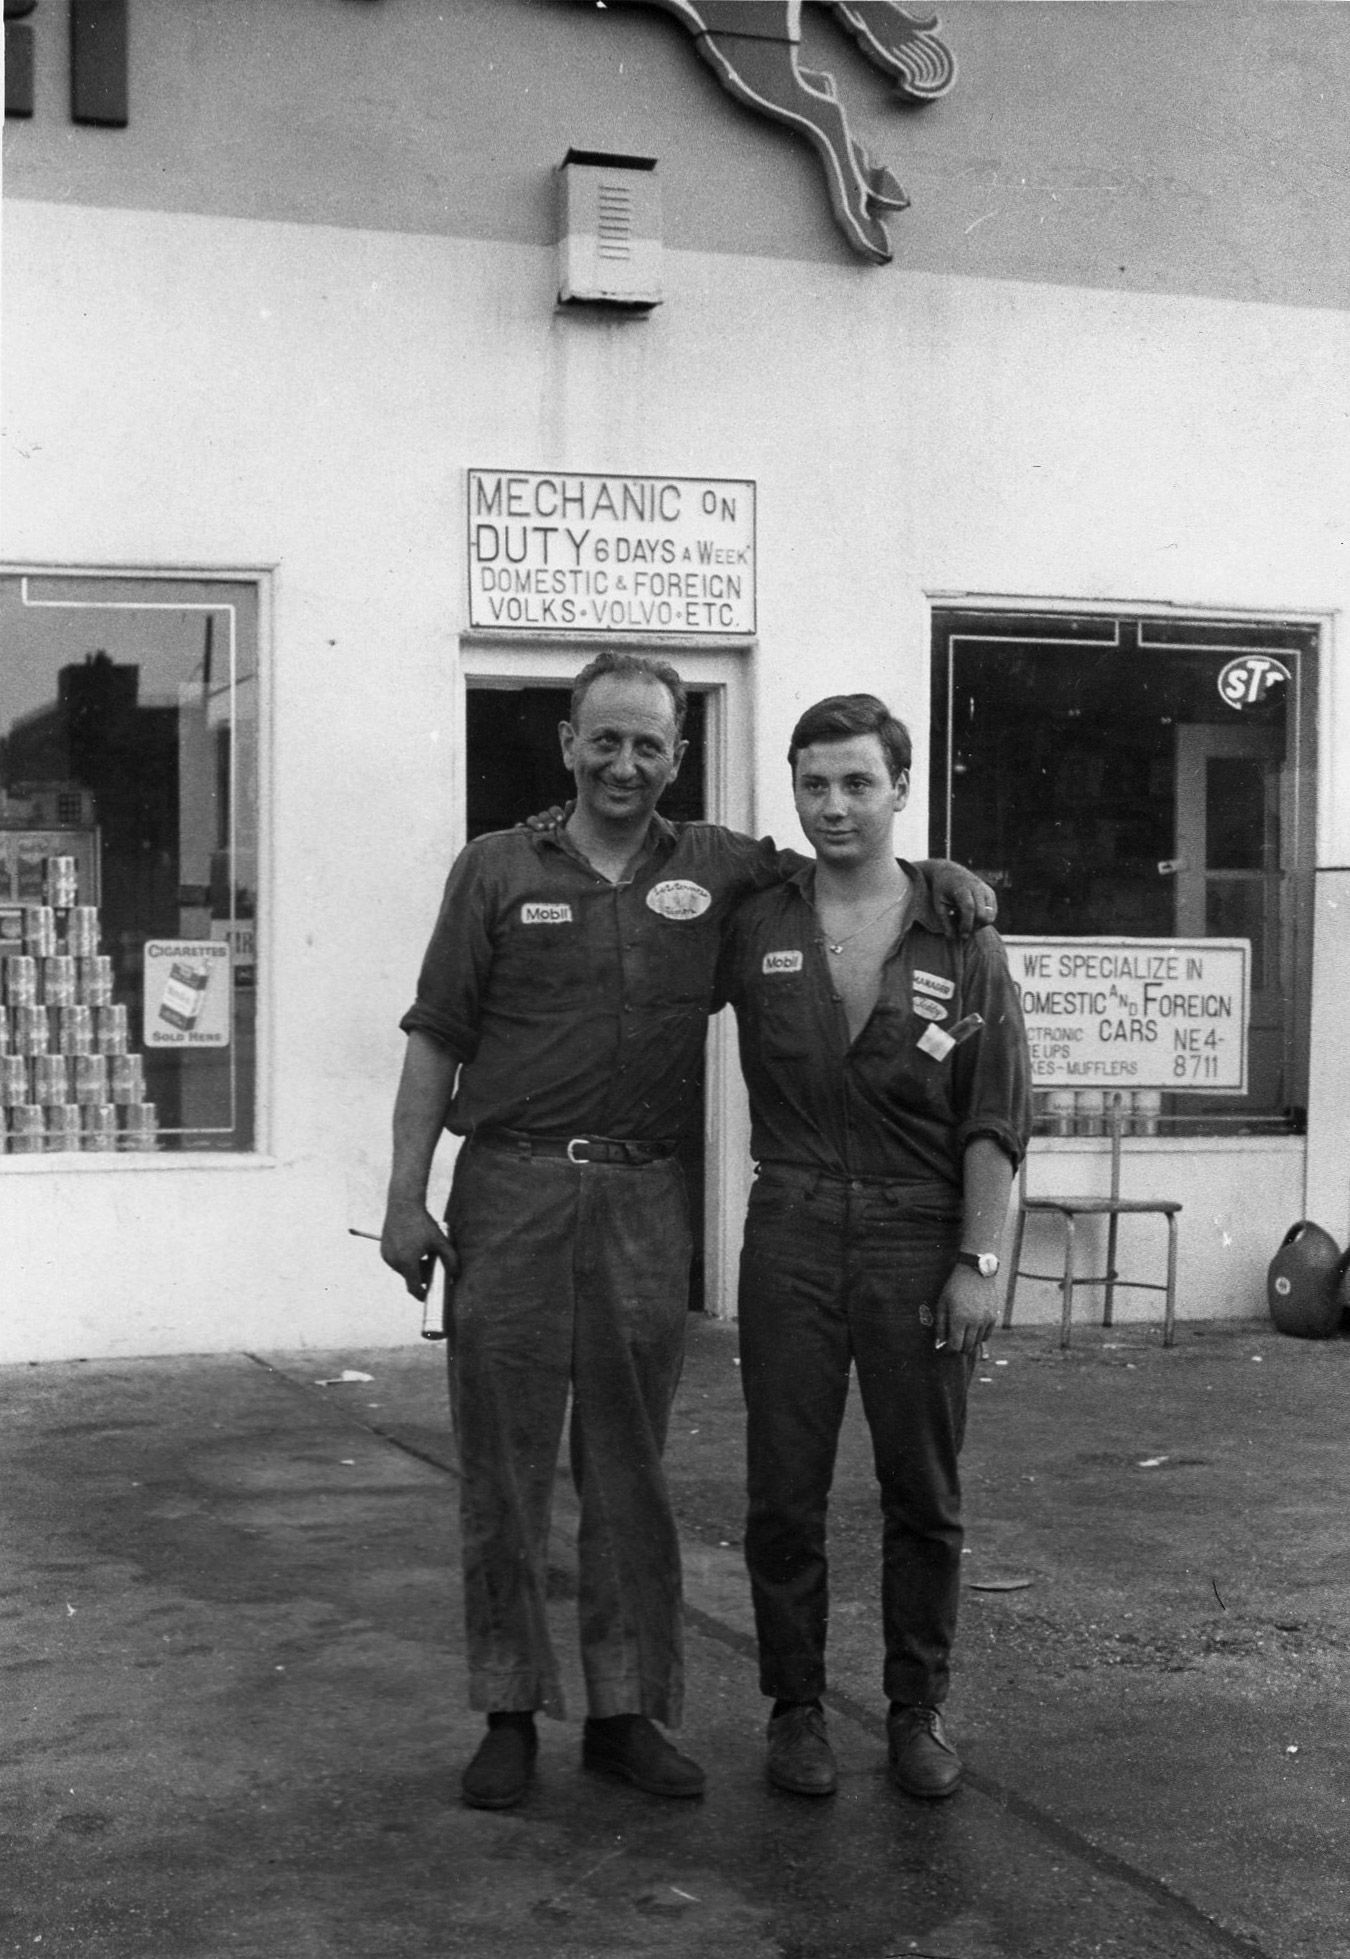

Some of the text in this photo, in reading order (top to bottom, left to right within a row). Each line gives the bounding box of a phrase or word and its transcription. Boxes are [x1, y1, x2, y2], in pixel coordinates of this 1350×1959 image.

[476, 477, 736, 522] MECHANIC ON
[476, 524, 747, 566] DUTY 6 DAYS A WEEK
[481, 566, 742, 599] DOMESTIC & FOREIGN
[526, 907, 568, 920] Mobil
[148, 944, 227, 958] CIGARETTES
[766, 955, 799, 969] Mobil
[1023, 954, 1203, 980] WE SPECIALIZE IN
[1109, 983, 1138, 1016] AND
[1143, 981, 1232, 1018] FOREIGN
[153, 1031, 185, 1042] SOLD
[1099, 1018, 1158, 1042] CARS
[1173, 1054, 1218, 1078] 8711
